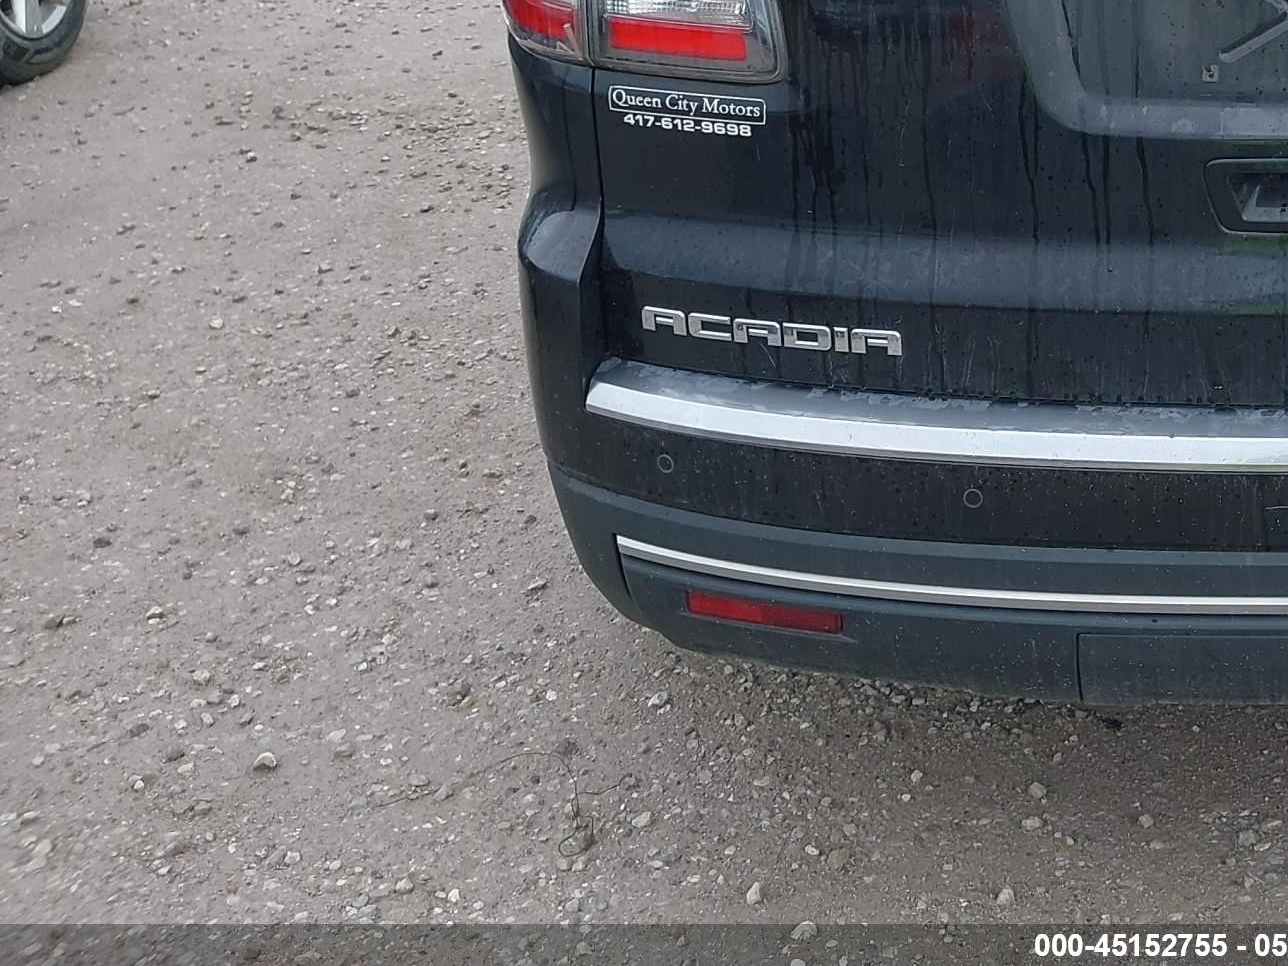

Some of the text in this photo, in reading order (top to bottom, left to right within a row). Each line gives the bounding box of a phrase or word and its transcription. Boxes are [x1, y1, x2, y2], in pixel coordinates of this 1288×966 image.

[612, 89, 761, 118] Queen City Motors
[623, 113, 752, 137] 417-612-9698
[641, 305, 903, 356] ACADIA
